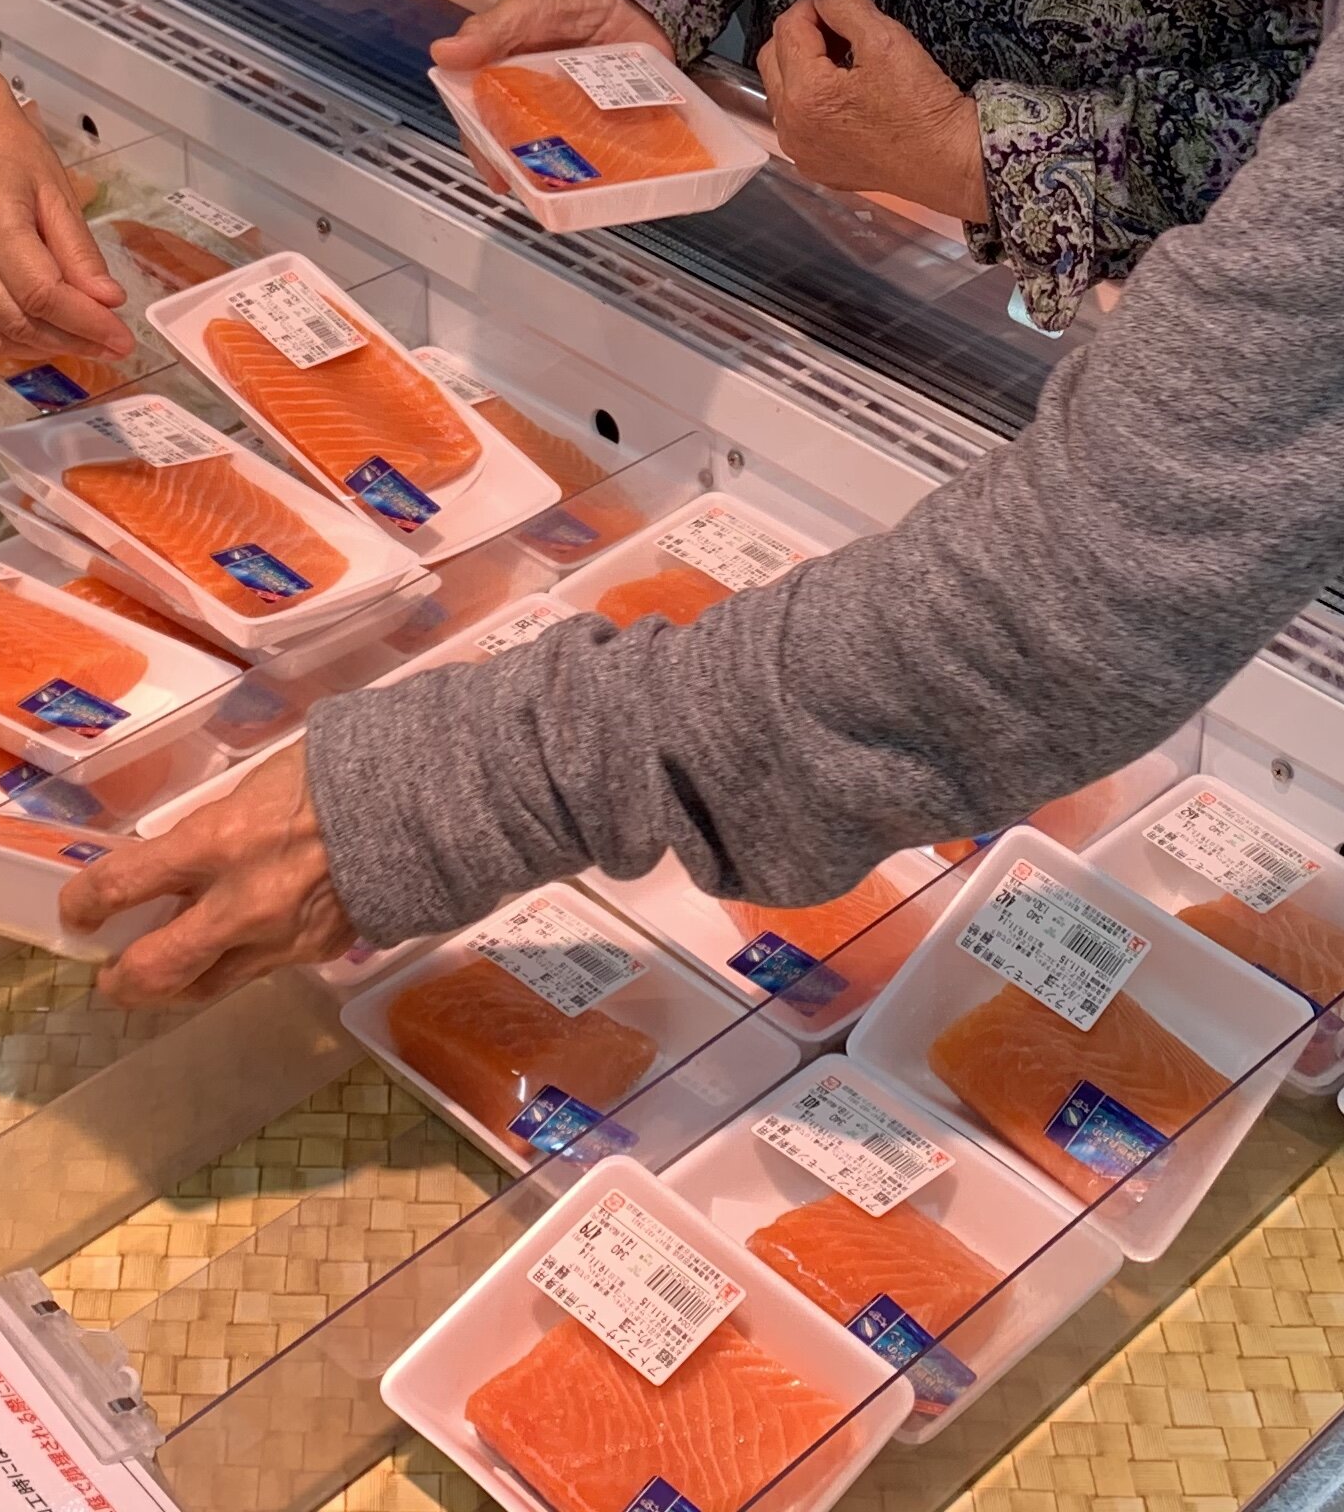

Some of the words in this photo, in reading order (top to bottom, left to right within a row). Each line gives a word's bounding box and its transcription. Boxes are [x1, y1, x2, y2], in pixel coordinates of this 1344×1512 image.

[997, 914, 1028, 938] 19.11.14
[1058, 954, 1091, 979] 19.11.15
[578, 1219, 604, 1242] 479
[577, 1247, 610, 1275] 19.11.14
[638, 1296, 673, 1326] 19.11.15
